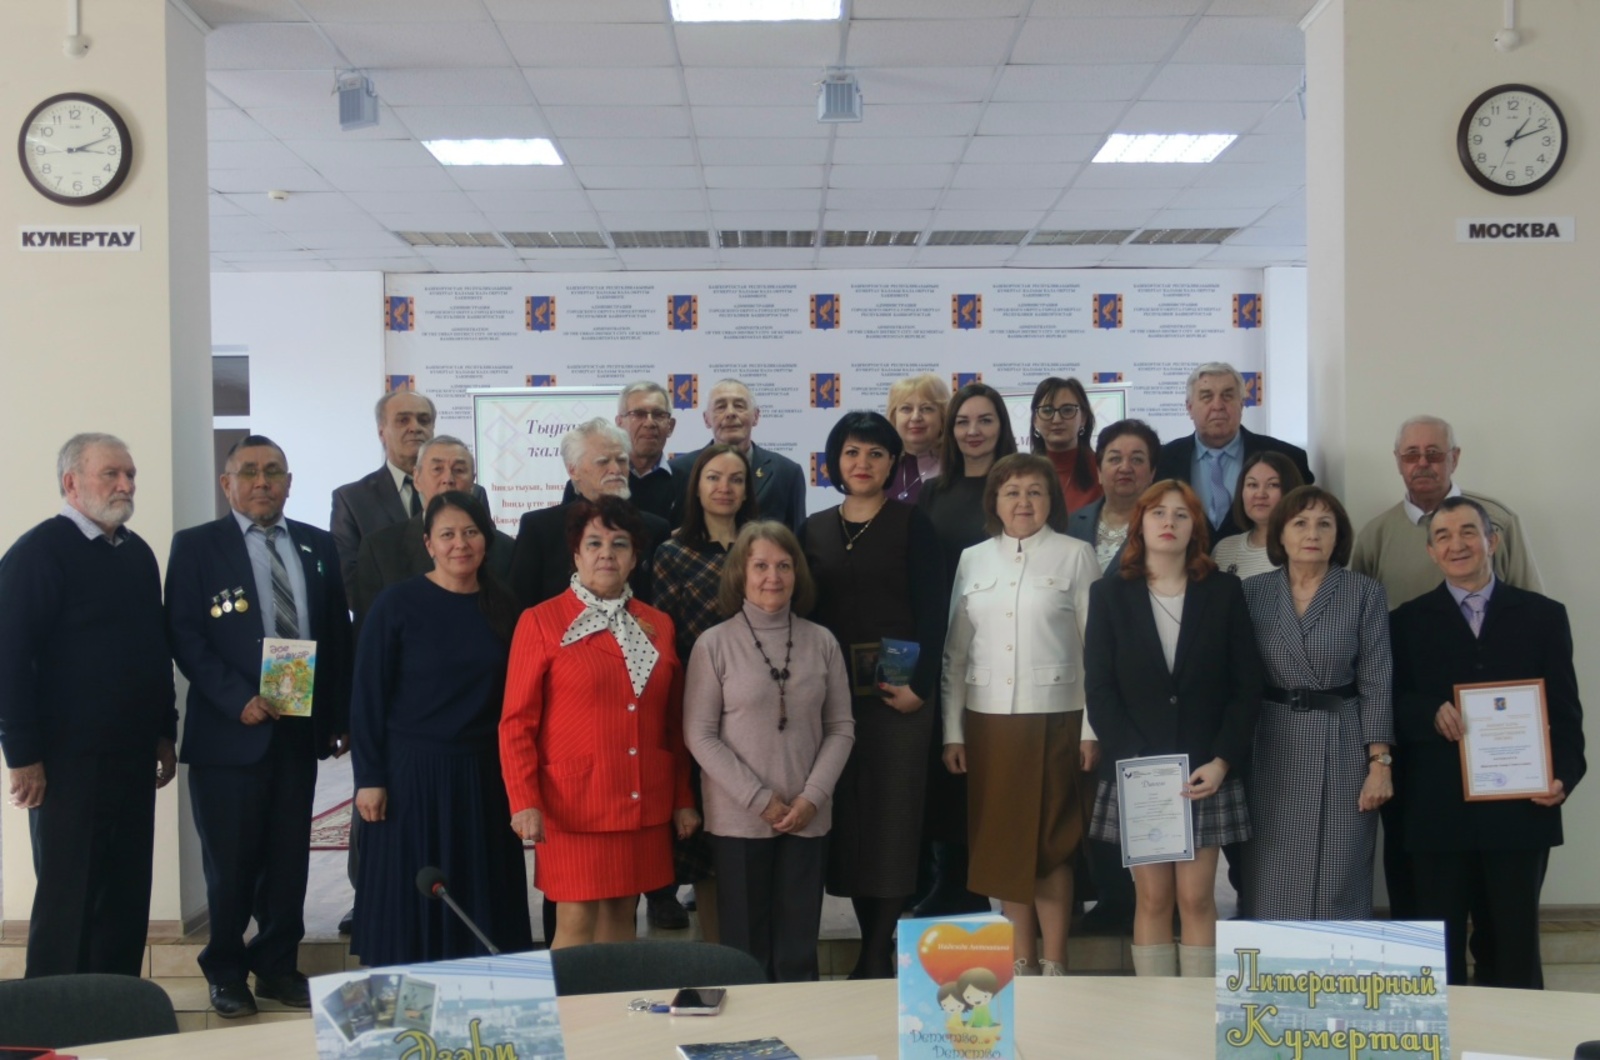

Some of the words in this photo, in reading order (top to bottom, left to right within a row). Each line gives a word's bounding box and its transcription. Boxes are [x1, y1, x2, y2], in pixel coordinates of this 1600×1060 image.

[1508, 101, 1519, 110] 12
[69, 110, 81, 120] 12
[1492, 106, 1499, 115] 11
[1528, 107, 1532, 115] 1
[53, 116, 61, 124] 11
[91, 116, 95, 124] 1
[1479, 117, 1490, 126] 10
[1538, 118, 1547, 128] 2
[40, 127, 53, 137] 10
[102, 127, 111, 136] 2
[1473, 135, 1482, 144] 9
[1542, 137, 1551, 147] 3
[36, 146, 46, 155] 9
[107, 146, 116, 155] 3
[1478, 153, 1487, 162] 8
[1537, 154, 1545, 163] 4
[42, 164, 52, 174] 8
[103, 164, 112, 172] 4
[1489, 166, 1496, 175] 7
[1525, 166, 1534, 176] 5
[1506, 171, 1515, 180] 6
[54, 176, 63, 186] 7
[92, 176, 102, 186] 5
[72, 181, 82, 191] 6
[1469, 223, 1560, 239] МОСКВА
[22, 232, 136, 247] КУМЕРТАУ
[1226, 948, 1436, 1010] Литературный
[1226, 1003, 1442, 1060] Кумертау
